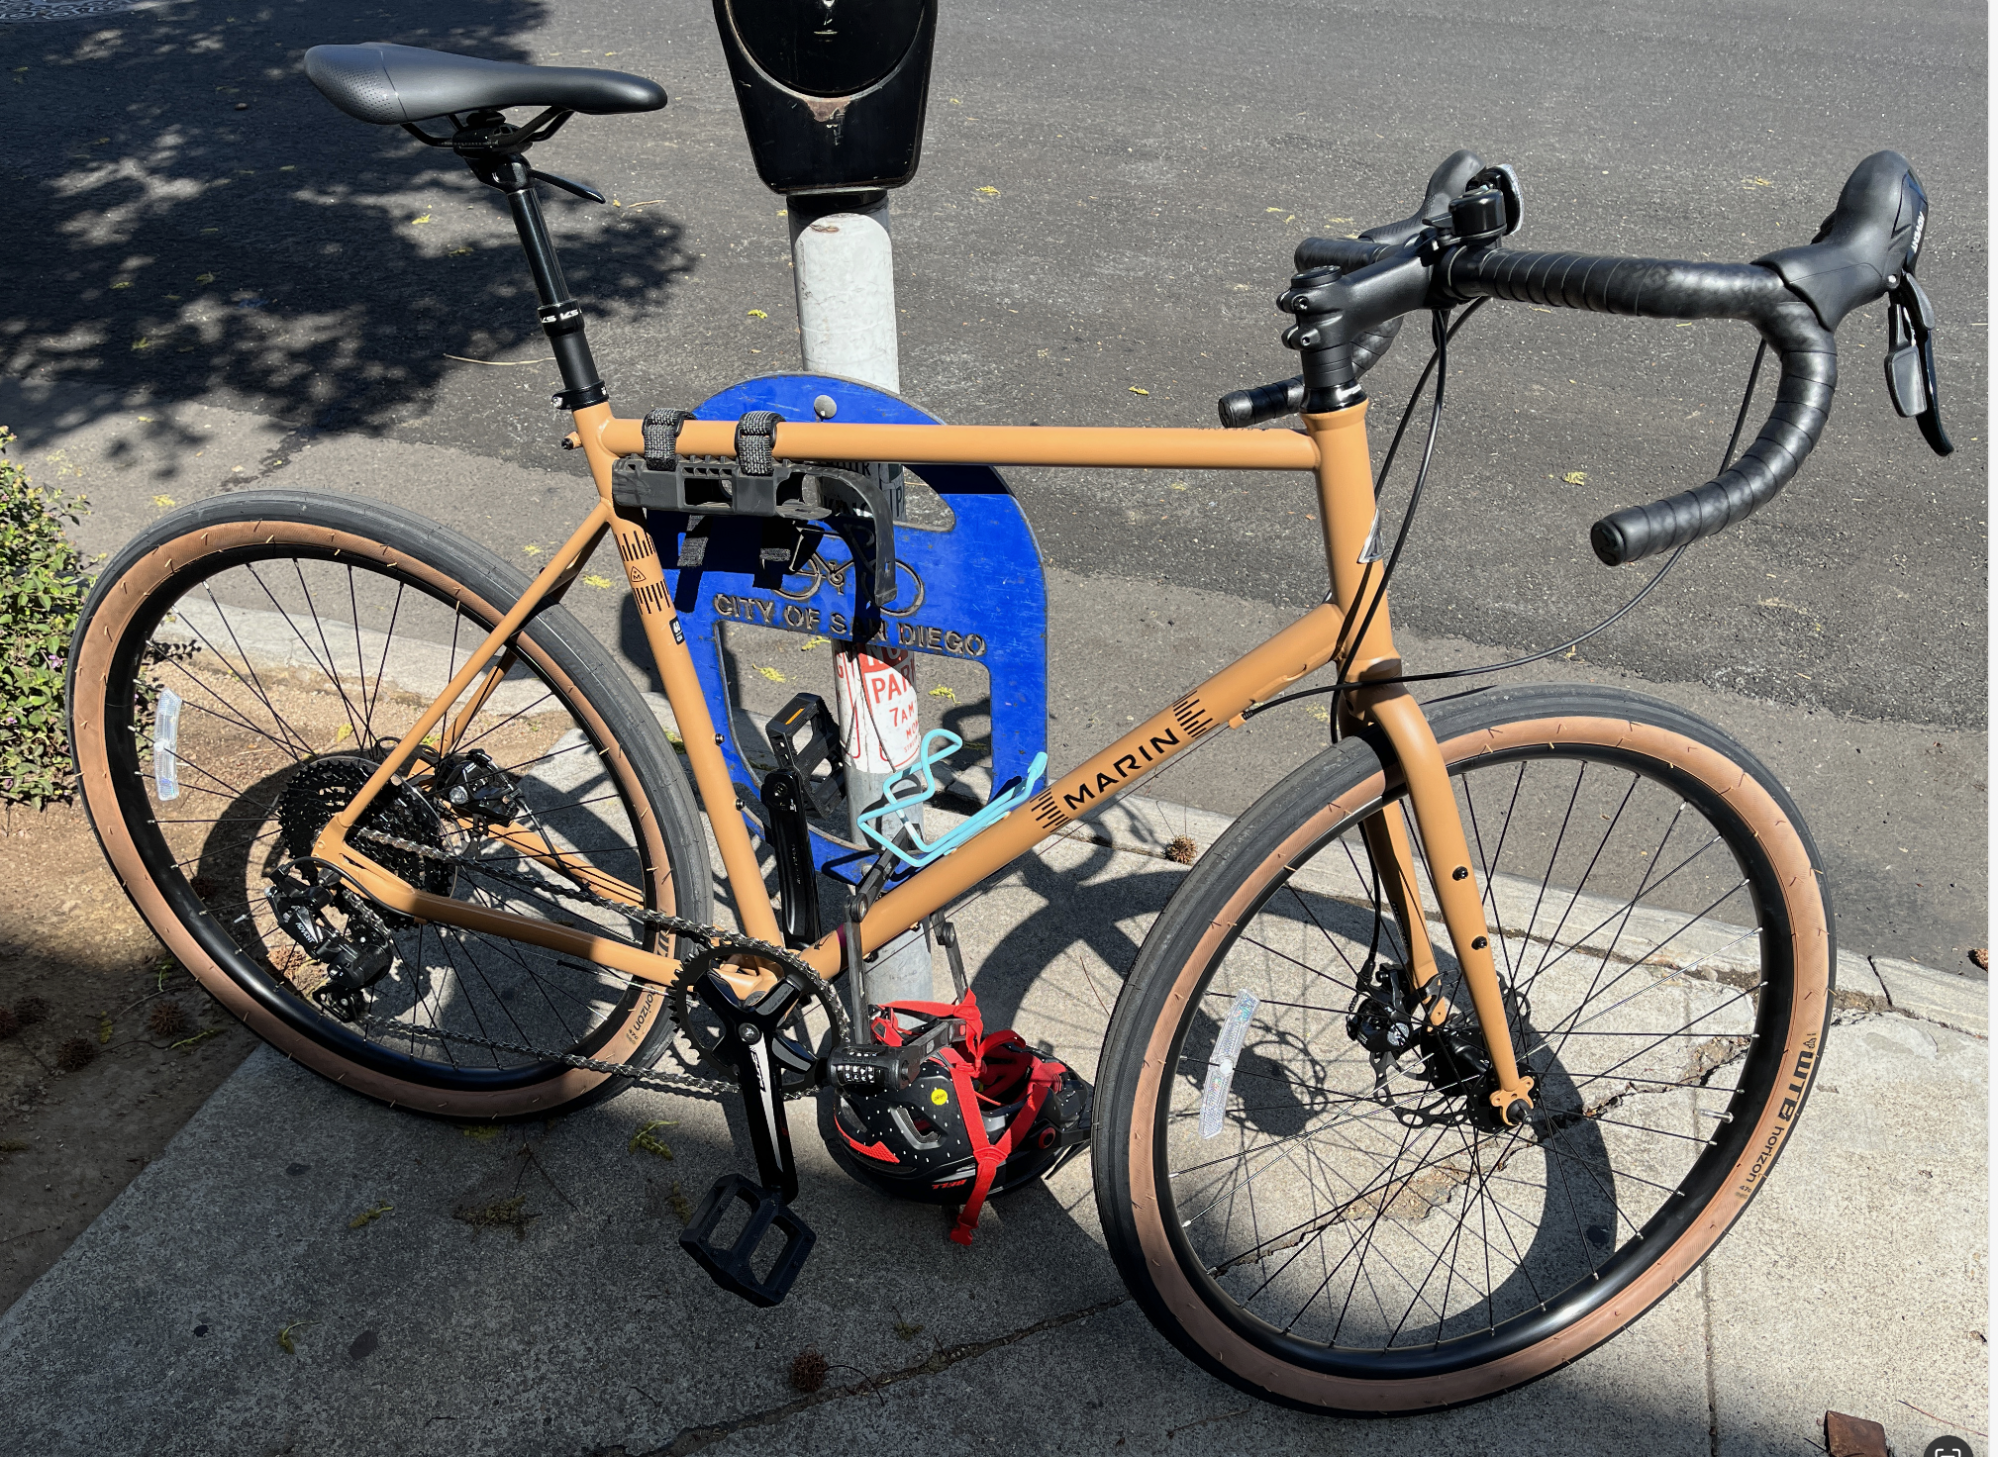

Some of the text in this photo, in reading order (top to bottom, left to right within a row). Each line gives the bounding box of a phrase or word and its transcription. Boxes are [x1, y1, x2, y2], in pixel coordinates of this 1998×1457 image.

[1910, 210, 1925, 253] ADVENT
[714, 593, 775, 623] CITY
[783, 605, 821, 630] OF
[898, 623, 986, 656] DIEGO
[1063, 728, 1180, 811] MARIN
[295, 922, 315, 943] ADVENT
[1746, 1051, 1815, 1183] WTB horizon
